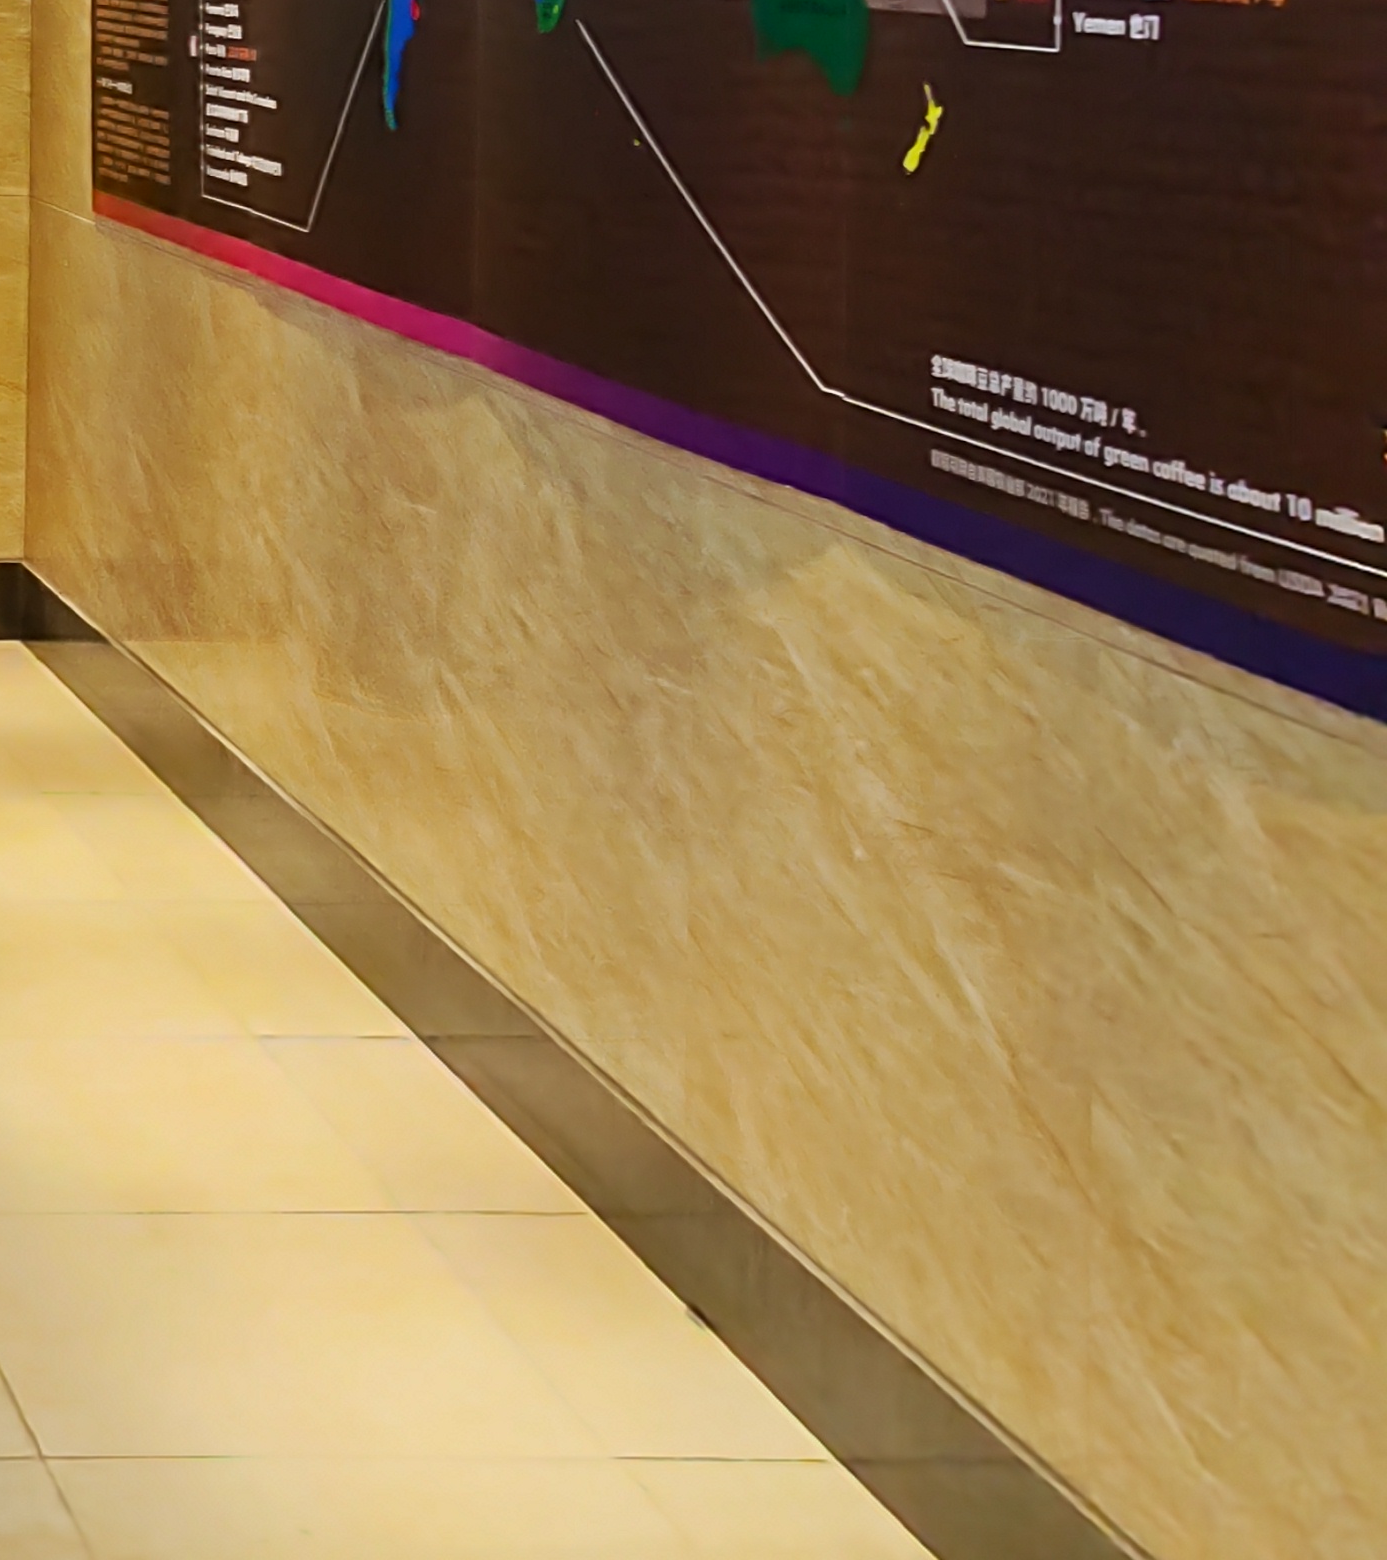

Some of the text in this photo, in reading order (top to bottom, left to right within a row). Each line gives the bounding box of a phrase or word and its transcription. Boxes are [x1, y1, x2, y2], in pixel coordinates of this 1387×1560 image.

[1072, 11, 1127, 37] Yemen
[1040, 386, 1077, 415] 1000
[930, 387, 956, 413] The
[957, 398, 989, 423] total
[990, 407, 1032, 436] global
[1033, 422, 1082, 452] output
[1084, 436, 1101, 458] of
[1103, 445, 1150, 473] green
[1153, 459, 1206, 491] coffee
[1209, 471, 1224, 496] is
[1227, 479, 1281, 513] about
[1285, 493, 1313, 522] 10
